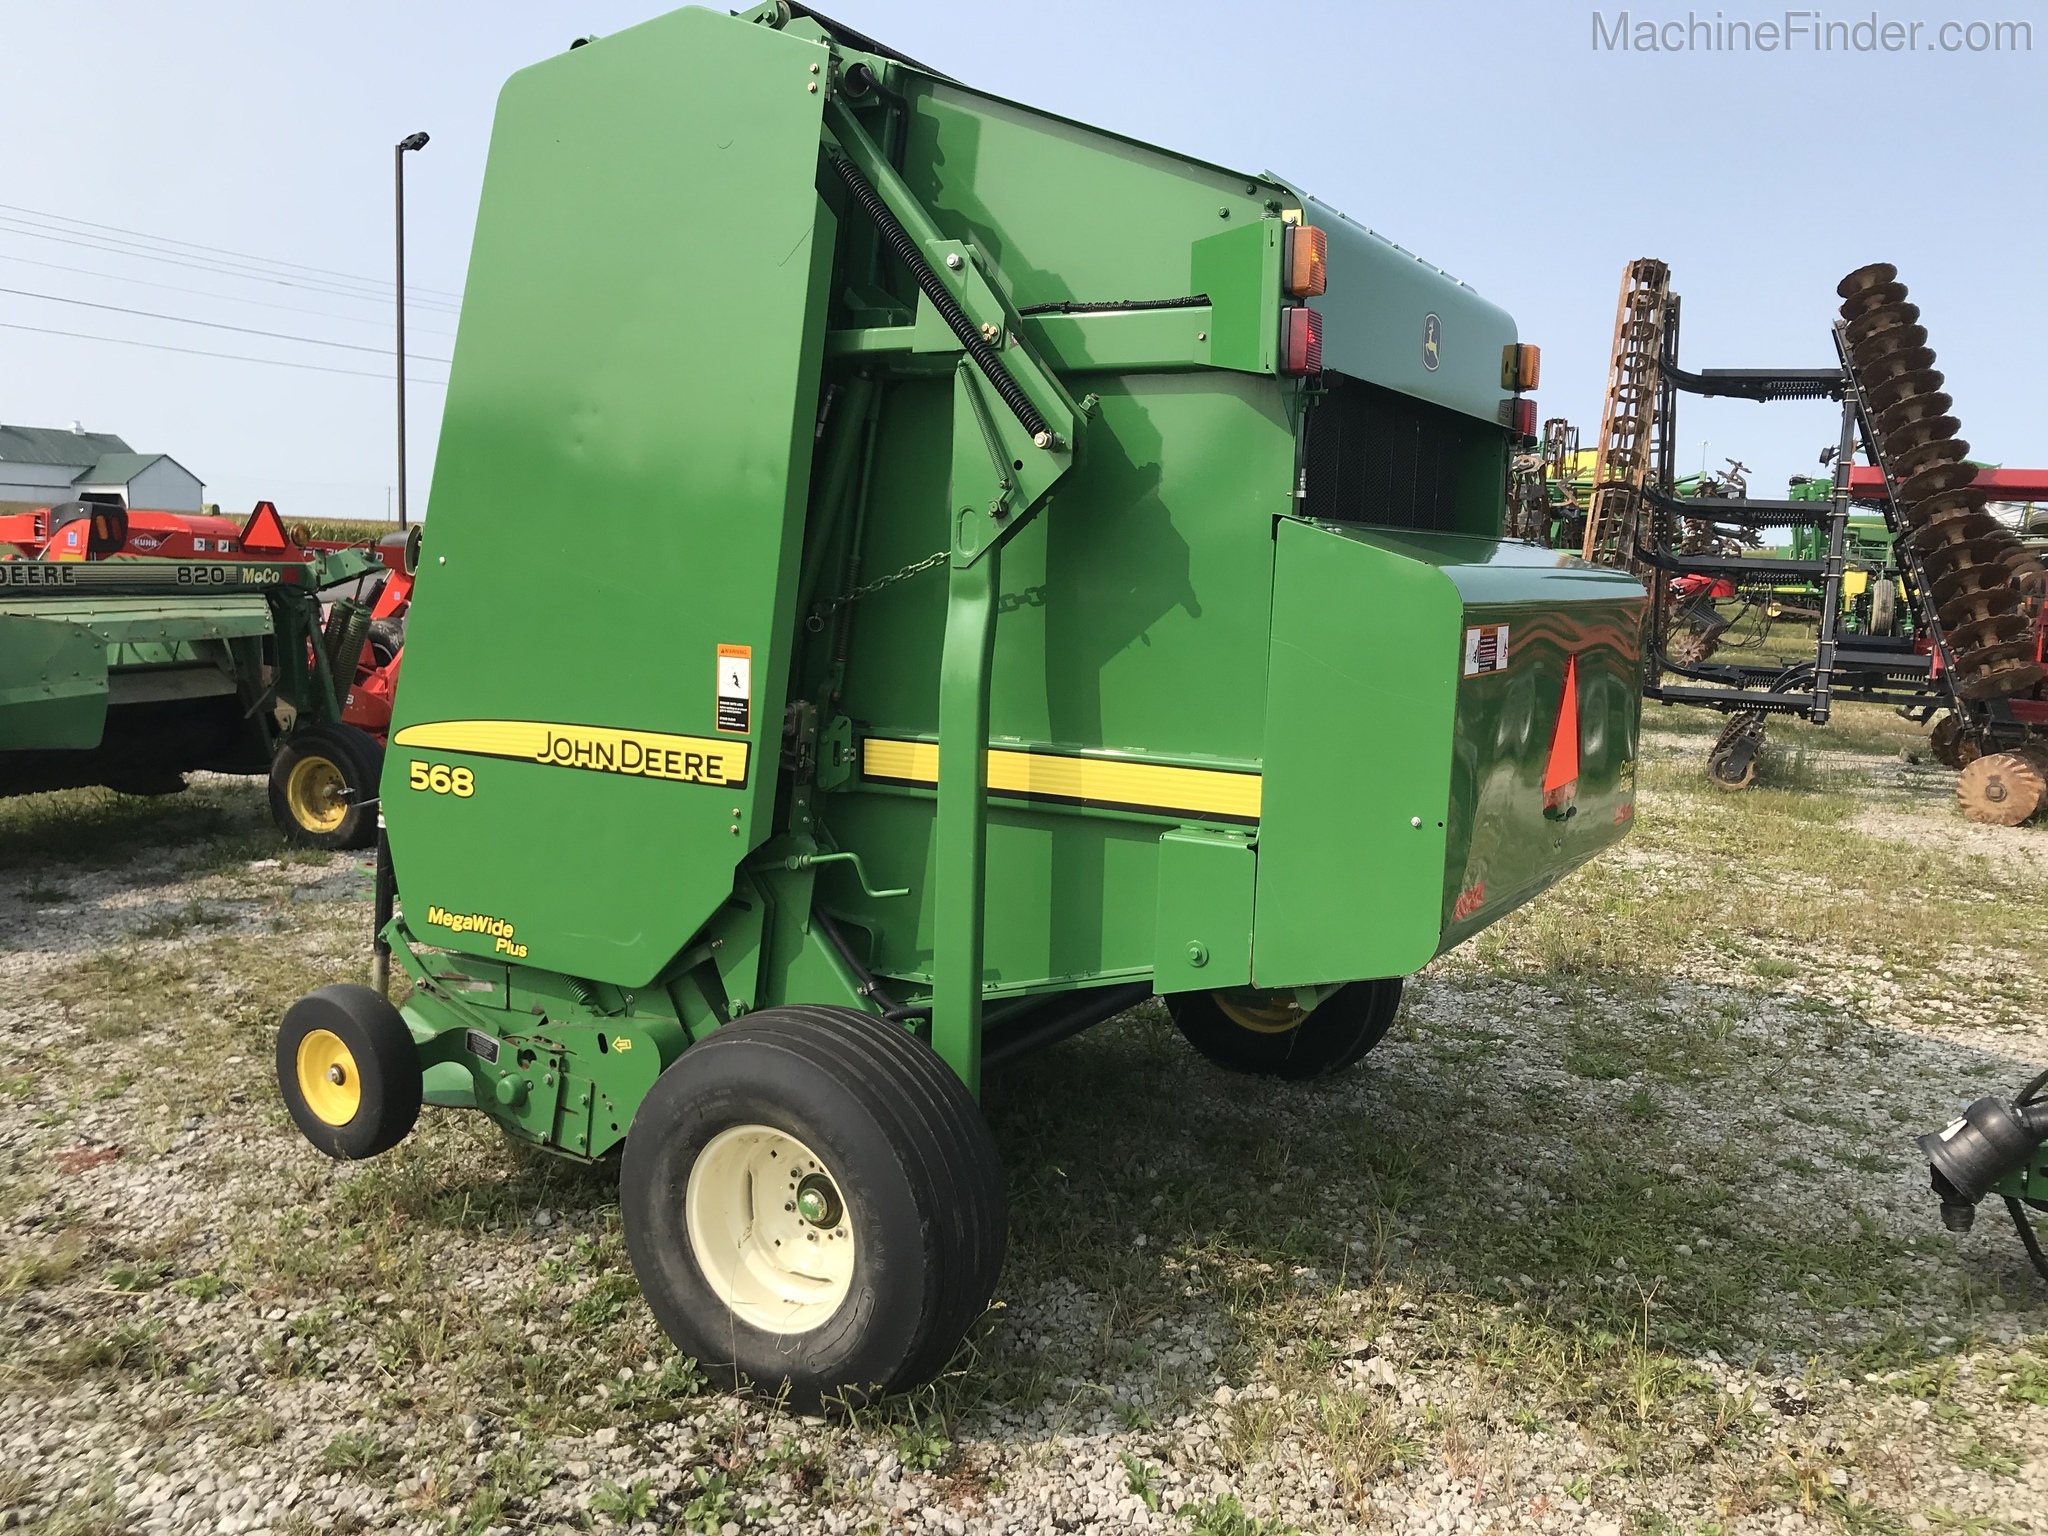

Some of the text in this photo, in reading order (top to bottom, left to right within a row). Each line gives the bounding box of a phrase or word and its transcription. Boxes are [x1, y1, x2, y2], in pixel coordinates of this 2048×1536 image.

[134, 537, 158, 548] KUHN
[176, 565, 226, 585] 820
[242, 567, 280, 584] MoCo
[537, 731, 724, 780] JOHN DEERE
[410, 760, 474, 798] 568
[427, 905, 515, 939] MegaWide
[495, 937, 529, 959] Plus
